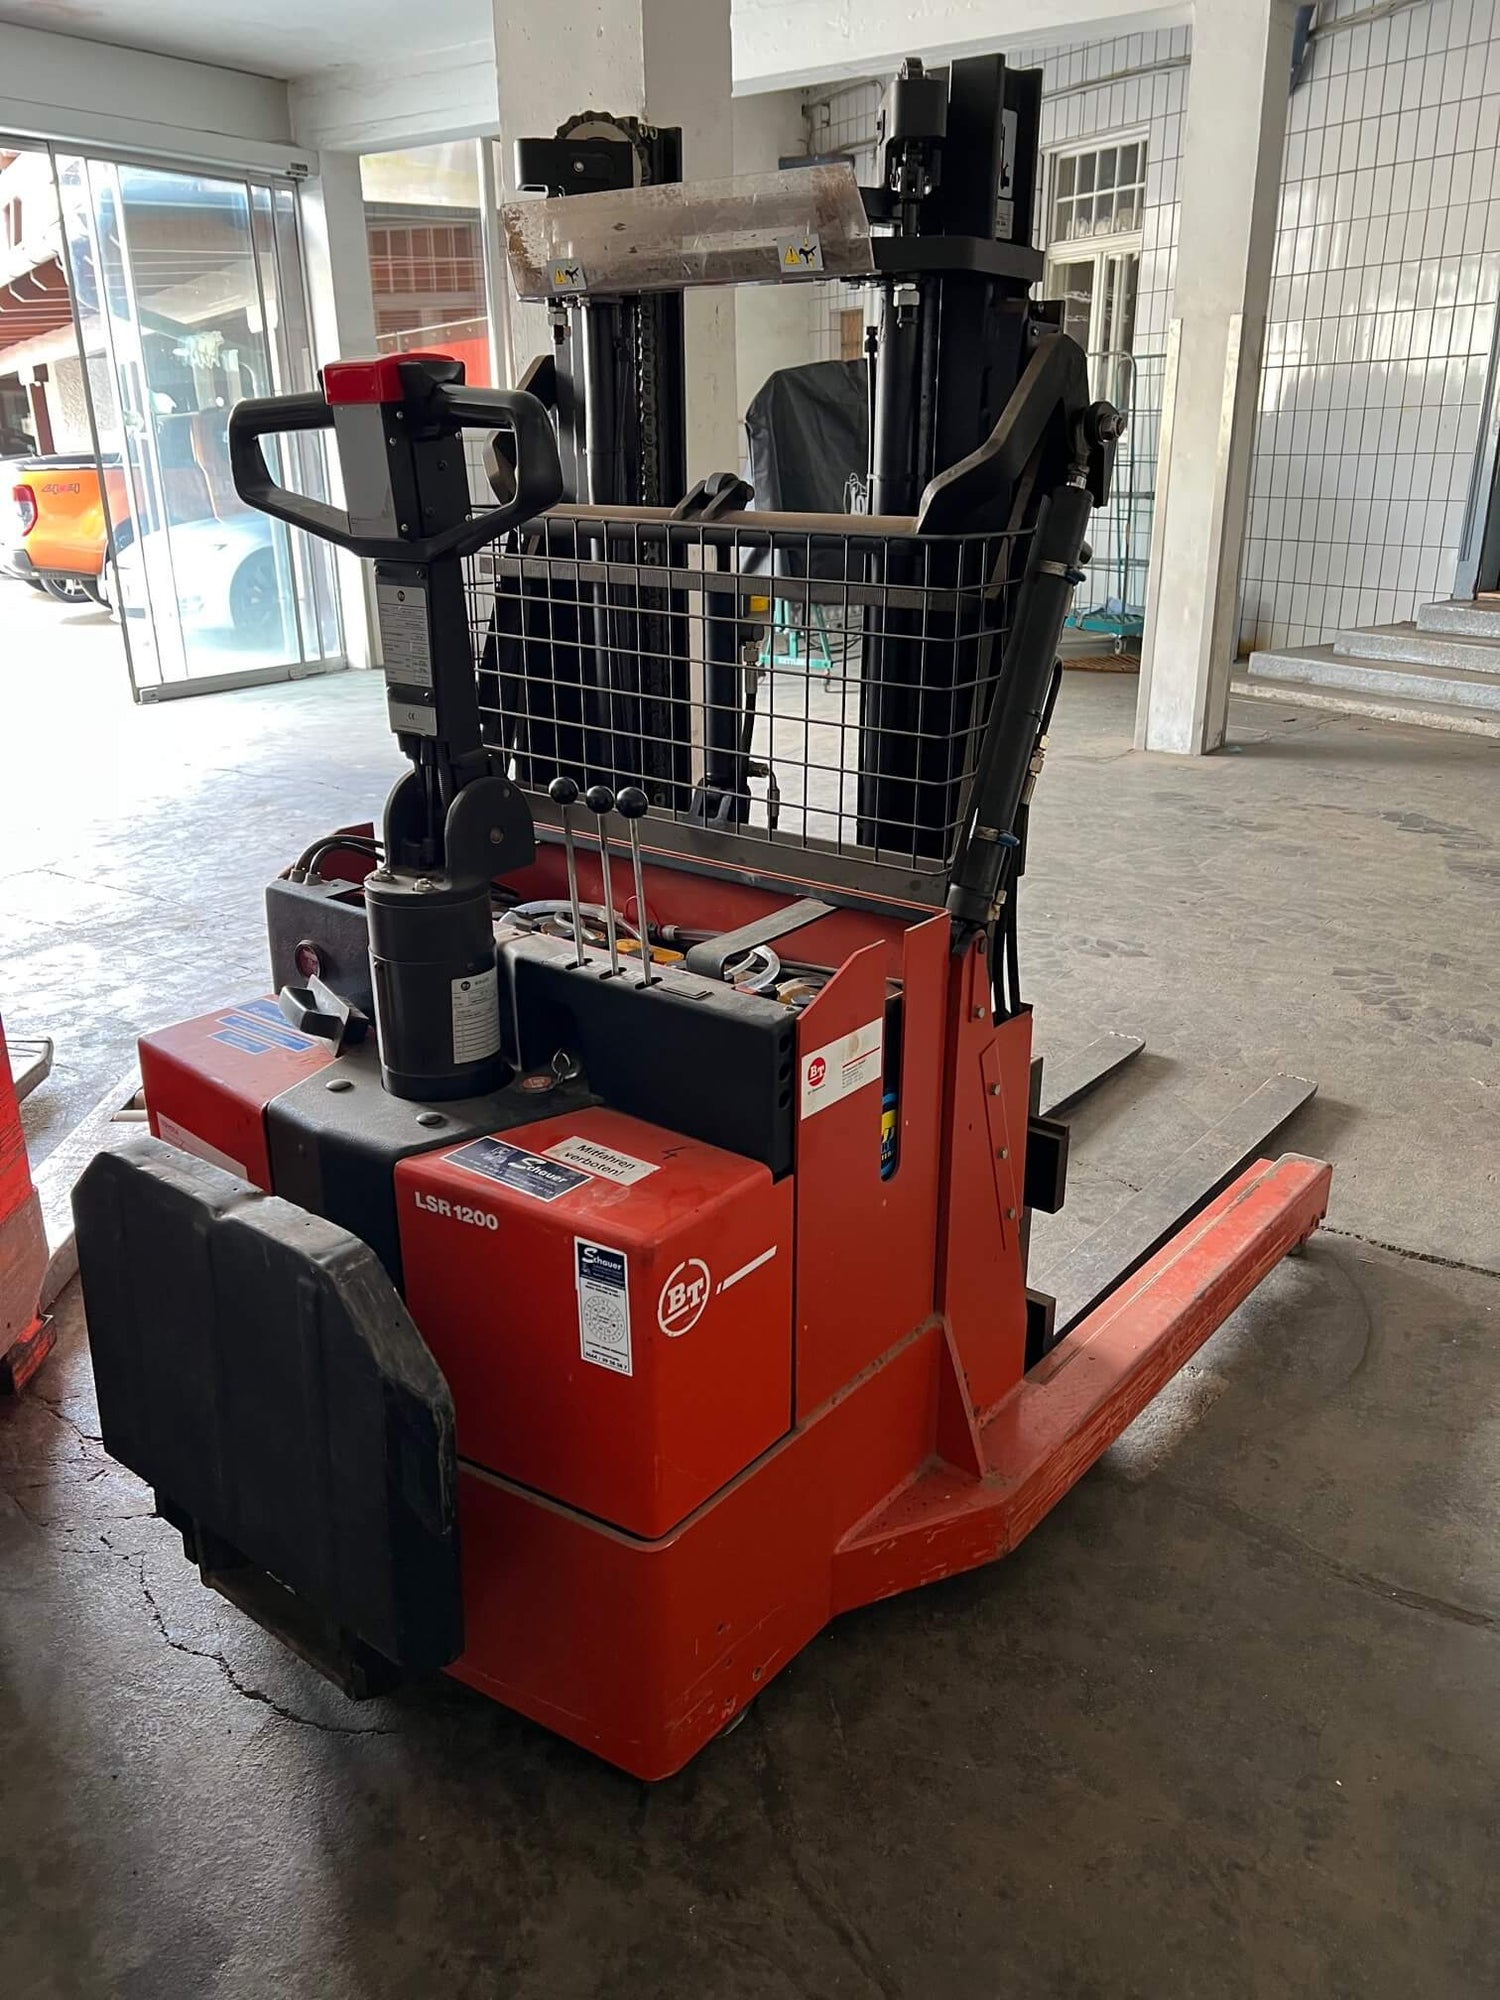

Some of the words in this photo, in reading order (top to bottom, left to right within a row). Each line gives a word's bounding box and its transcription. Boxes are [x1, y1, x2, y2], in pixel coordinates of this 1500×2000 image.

[564, 1151, 625, 1177] verboten!
[577, 1143, 636, 1170] Mitfahren
[508, 1157, 568, 1184] Schauer
[414, 1191, 452, 1217] LSR
[453, 1204, 499, 1230] 1200
[581, 1247, 623, 1271] Schauer
